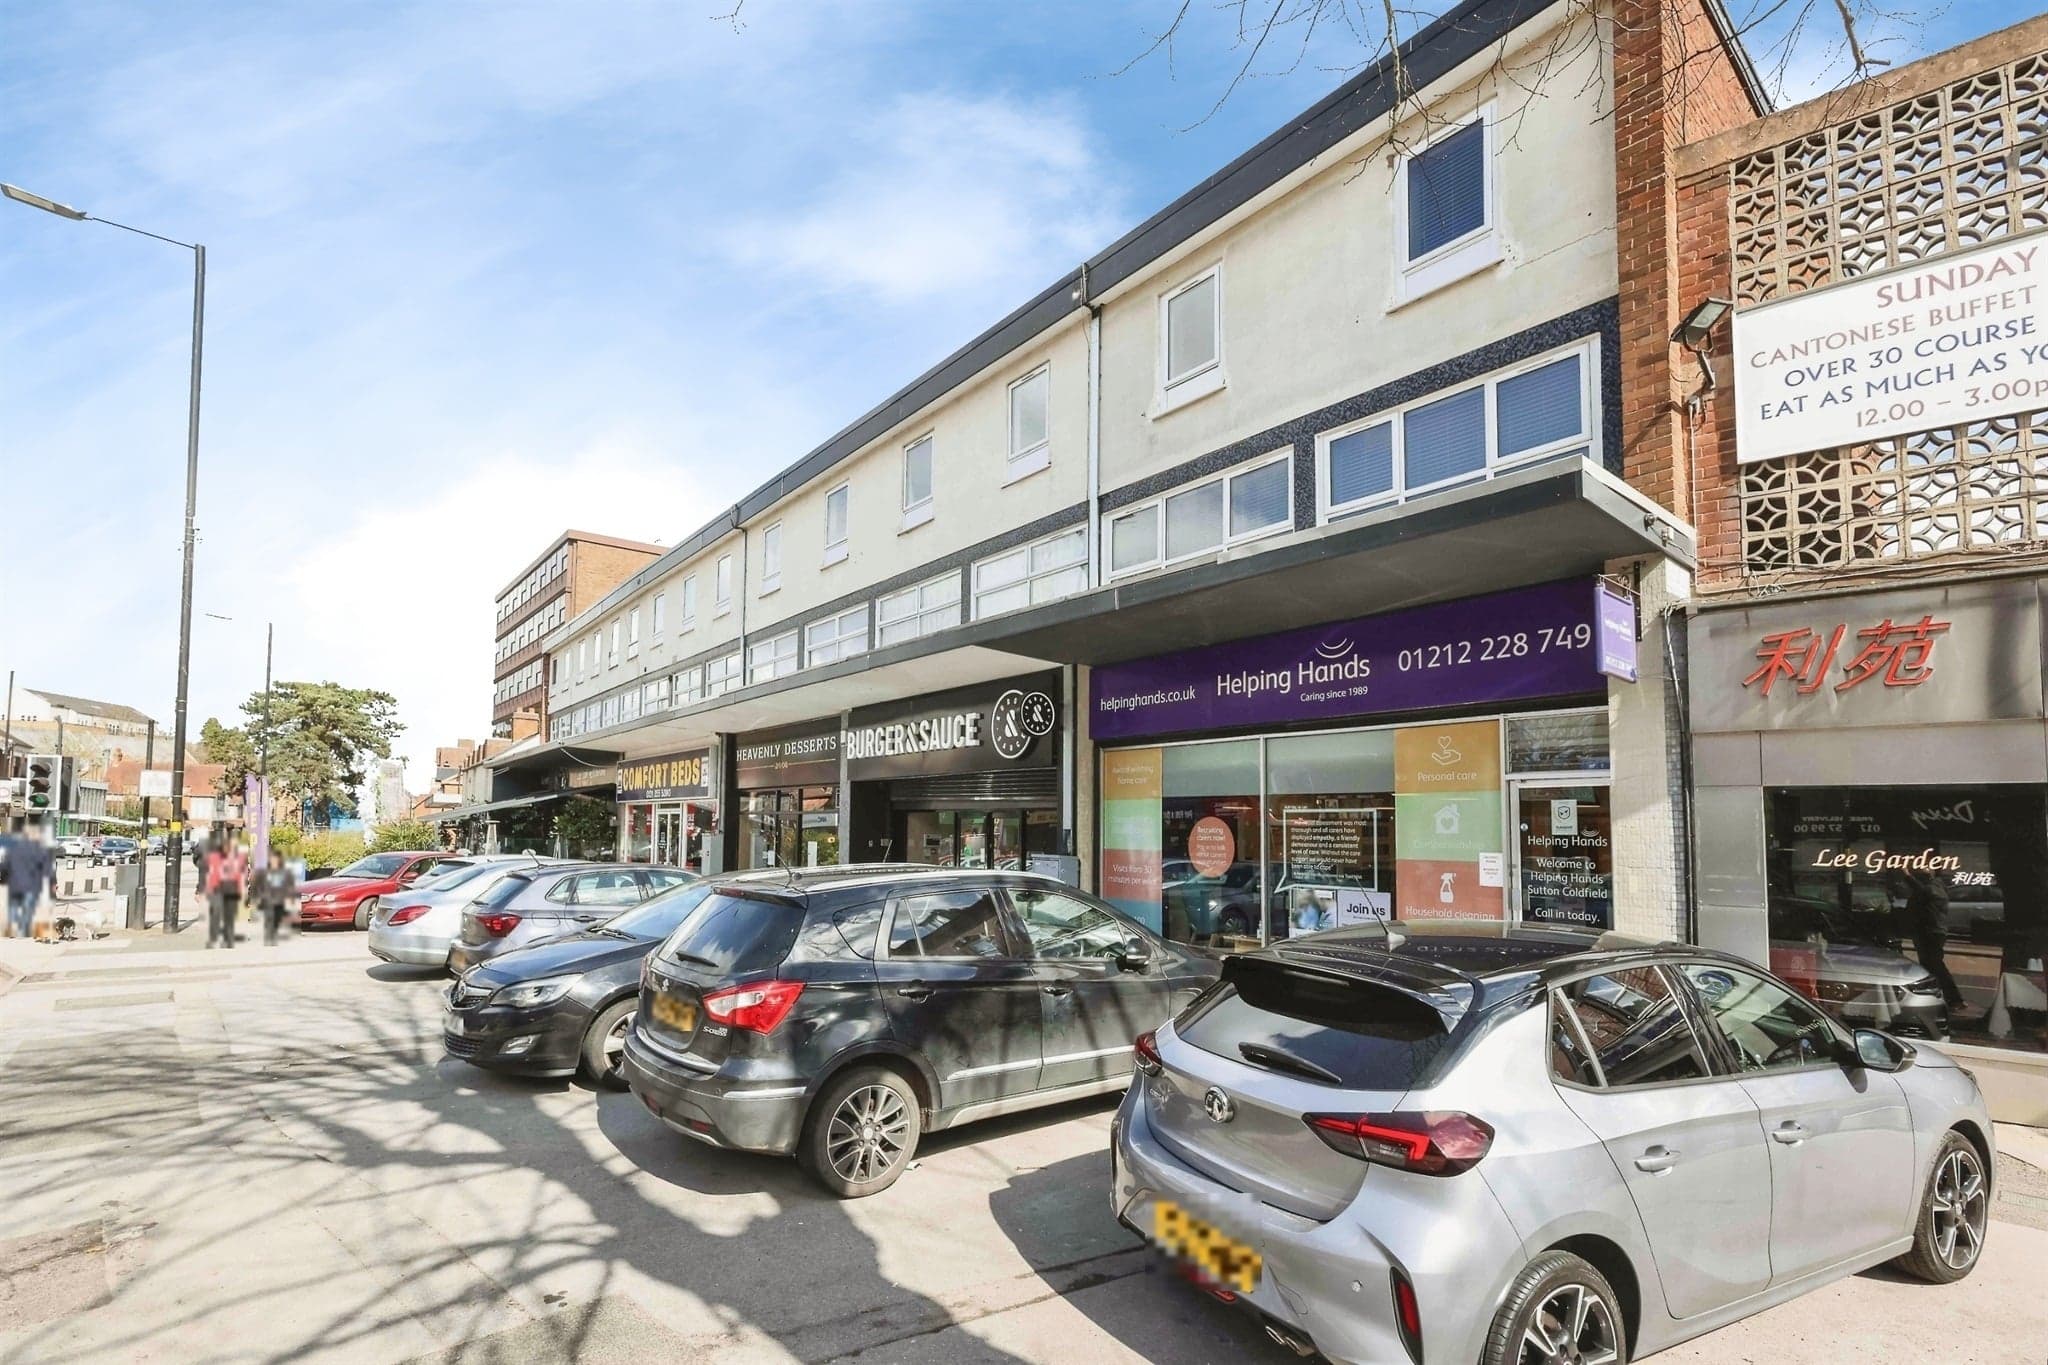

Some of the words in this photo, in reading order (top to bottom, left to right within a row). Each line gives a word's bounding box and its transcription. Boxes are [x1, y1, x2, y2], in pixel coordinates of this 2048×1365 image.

[1876, 246, 2038, 309] SUNDAY
[1750, 314, 1916, 369] CANTONESE
[1929, 284, 2038, 327] BUFFET
[1784, 357, 1857, 387] OVER
[1869, 346, 1903, 369] 30
[1914, 315, 2036, 358] COURSE
[1761, 395, 1808, 420] EAT
[1819, 385, 1853, 409] AS
[1866, 363, 1955, 398] MUCH
[1968, 352, 2007, 377] AS
[1857, 399, 1925, 428] 12.00
[1398, 641, 1472, 671] 01212
[1480, 632, 1529, 661] 228
[1537, 623, 1591, 653] 749
[1742, 615, 1952, 696] 利苑
[1217, 669, 1292, 698] Helping
[1298, 653, 1371, 685] Hands
[1100, 685, 1196, 711] helpinghands.co.uk
[1300, 691, 1326, 702] Caring
[1326, 687, 1347, 699] since
[1348, 686, 1368, 697] 1989
[736, 743, 781, 761] HEAVENLY
[784, 736, 837, 755] DESSERTS
[622, 762, 669, 791] COMFORT
[670, 758, 700, 787] BEDS
[1417, 771, 1456, 782] Personal
[1456, 772, 1477, 780] care
[1527, 835, 1569, 848] Helping
[1571, 836, 1608, 847] Hands
[1536, 858, 1582, 869] Welcome
[1585, 860, 1596, 869] to
[1811, 848, 1858, 867] Lee
[1864, 848, 1961, 874] Garden
[1530, 871, 1568, 885] Helping
[1570, 873, 1604, 884] Hands
[1951, 871, 1995, 886] 利苑
[1527, 885, 1560, 895] Sutton
[1562, 887, 1608, 899] Coldfield
[1346, 903, 1369, 915] Join
[1371, 906, 1386, 916] us
[1405, 905, 1453, 918] Household
[1535, 907, 1553, 918] Call
[1555, 909, 1565, 919] in
[1567, 911, 1600, 924] today.
